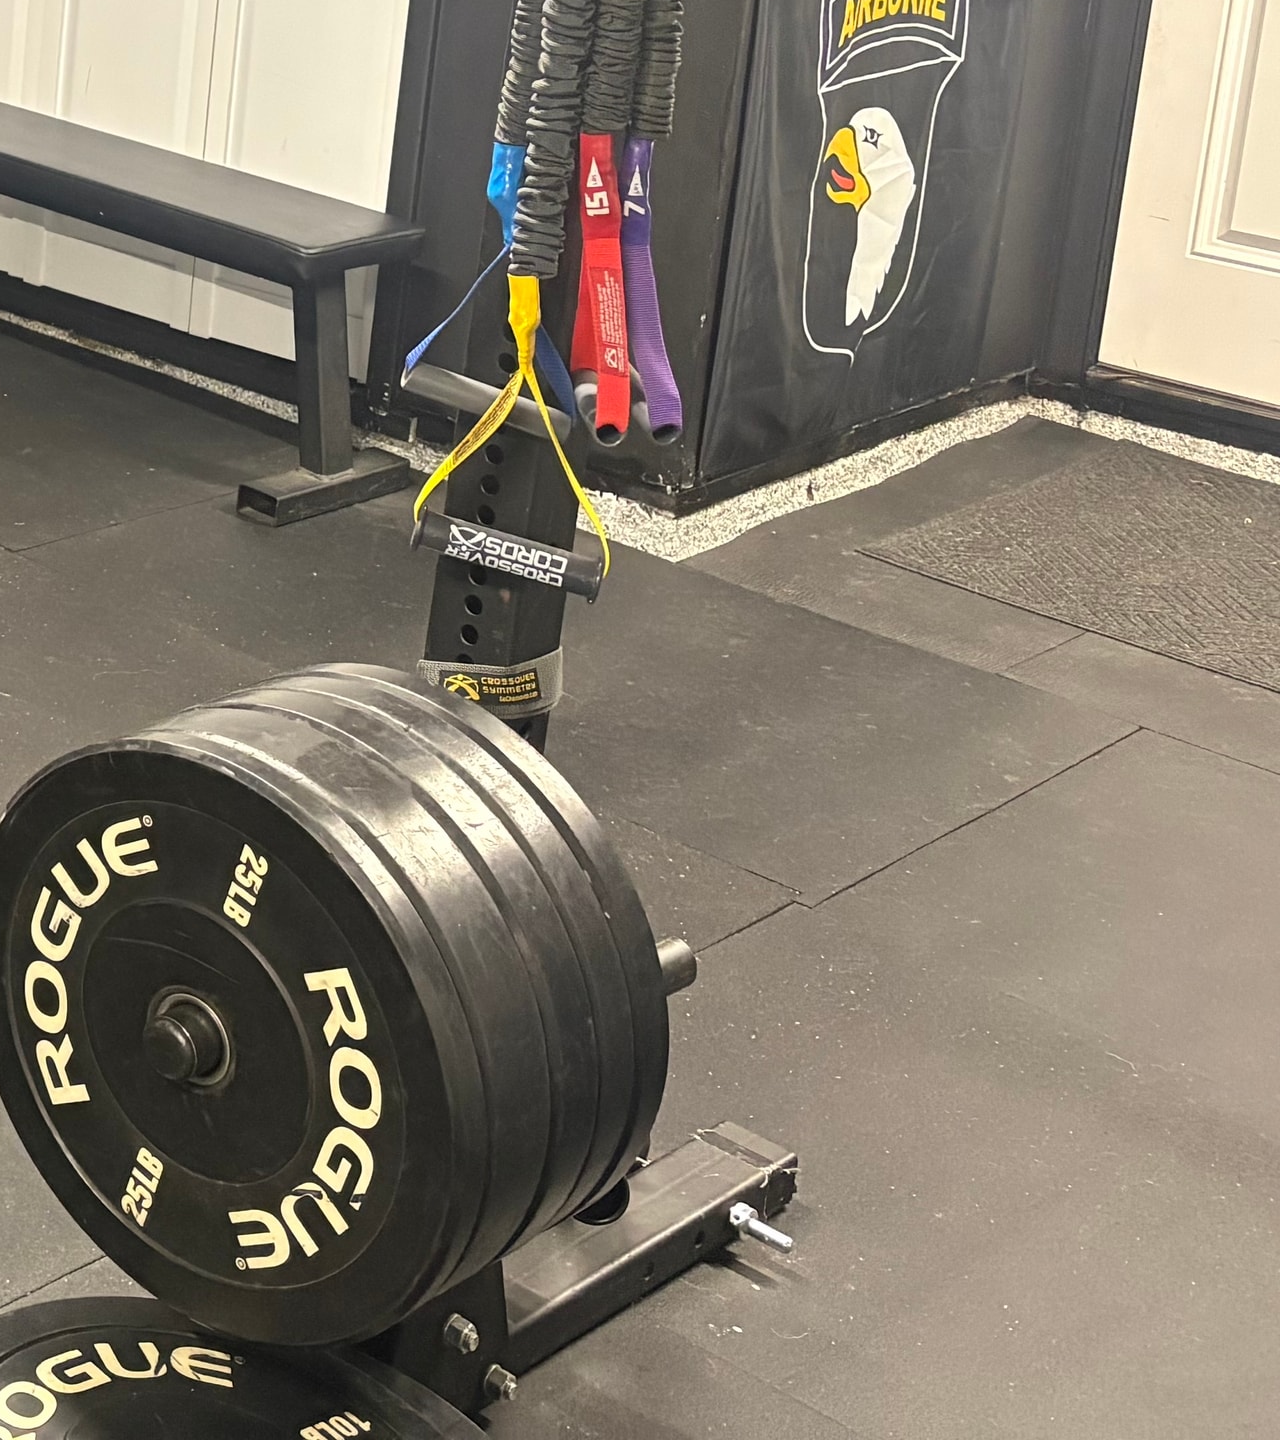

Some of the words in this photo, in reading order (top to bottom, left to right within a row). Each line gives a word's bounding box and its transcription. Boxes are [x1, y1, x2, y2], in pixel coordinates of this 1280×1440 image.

[584, 191, 610, 217] 15
[623, 199, 646, 217] 7
[444, 544, 564, 588] CROSSOVER
[483, 536, 568, 574] CORDS
[481, 672, 536, 686] CROSSOVER
[482, 681, 536, 694] SYMMETRY
[223, 843, 269, 928] 25LB
[25, 817, 159, 1105] ROGUE
[228, 967, 382, 1270] ROGUE
[120, 1147, 164, 1227] 25LB
